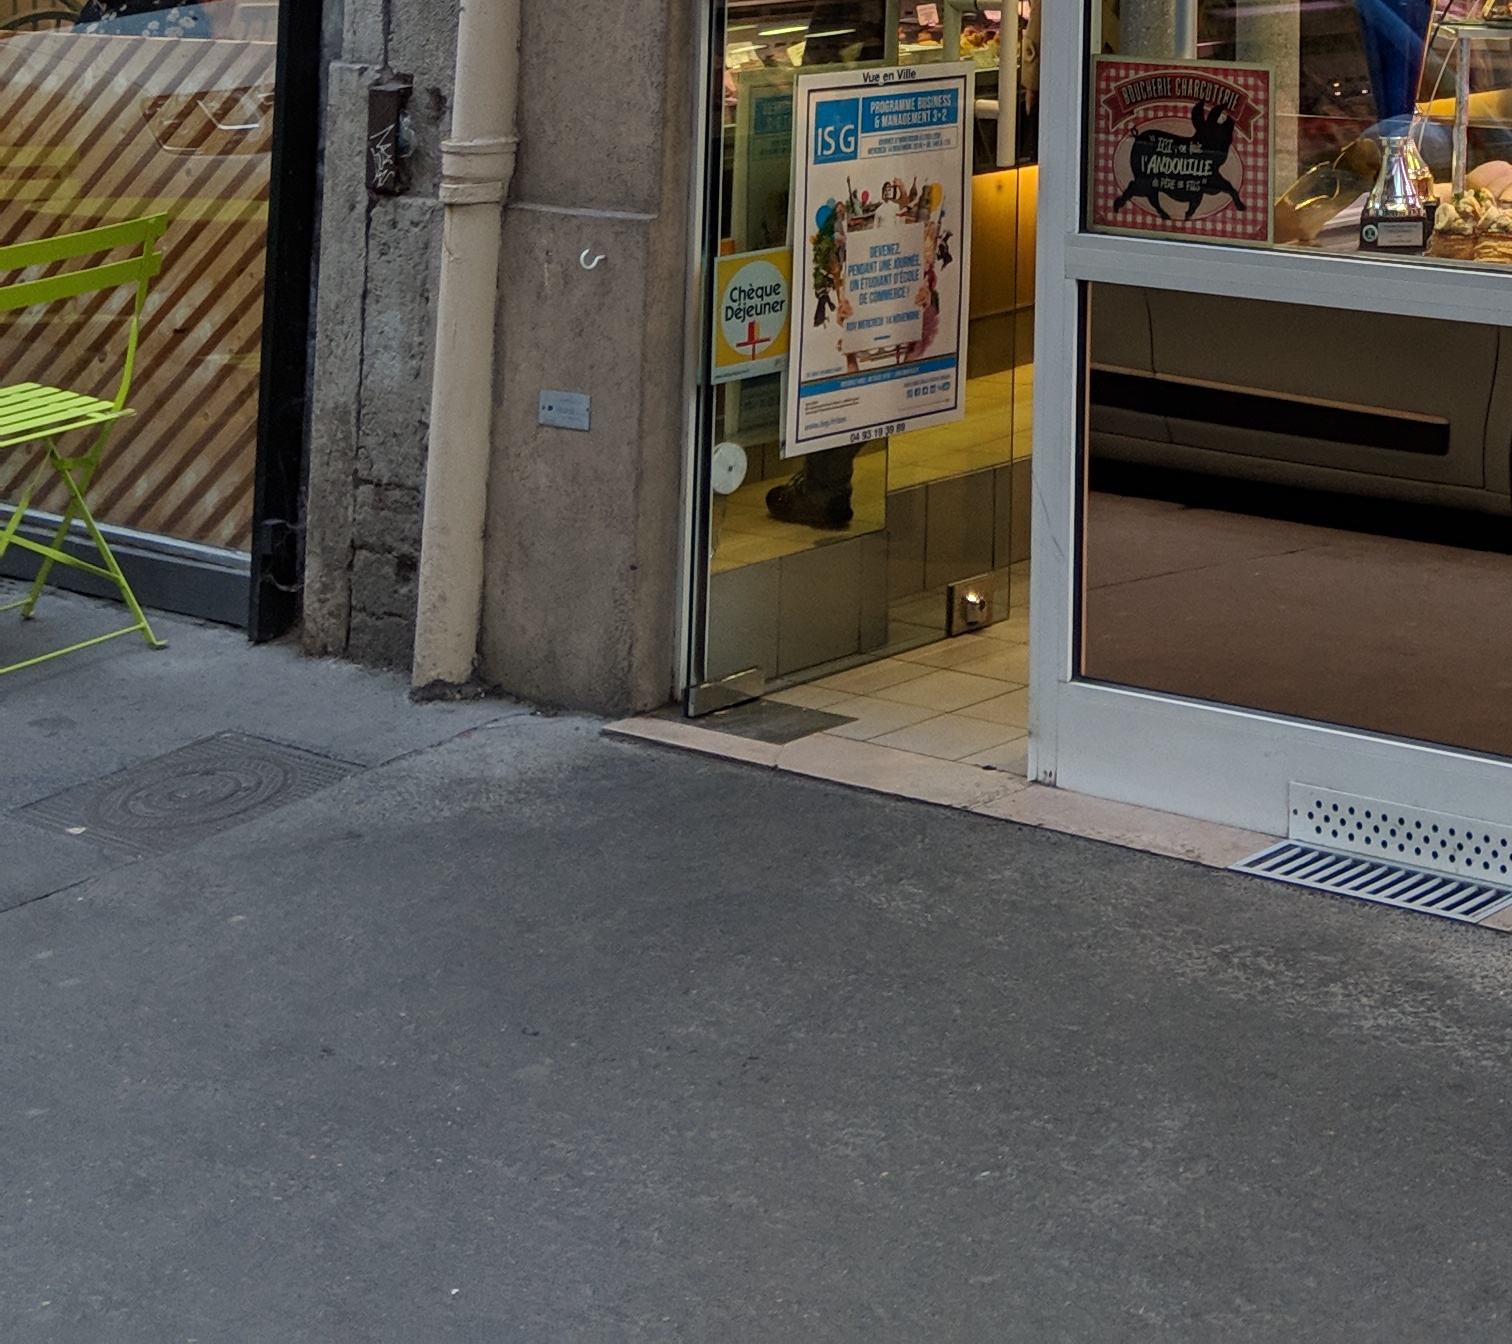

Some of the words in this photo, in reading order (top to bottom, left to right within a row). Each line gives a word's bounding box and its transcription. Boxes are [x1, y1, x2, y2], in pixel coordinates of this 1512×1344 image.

[862, 72, 880, 83] Vue
[883, 72, 894, 81] en
[897, 69, 916, 80] Ville
[1121, 76, 1172, 105] BOUCHERIE
[1175, 77, 1240, 111] CHARCUTERIE
[817, 124, 855, 156] ISG
[730, 283, 782, 303] Chèque
[725, 299, 786, 323] Déjeuner
